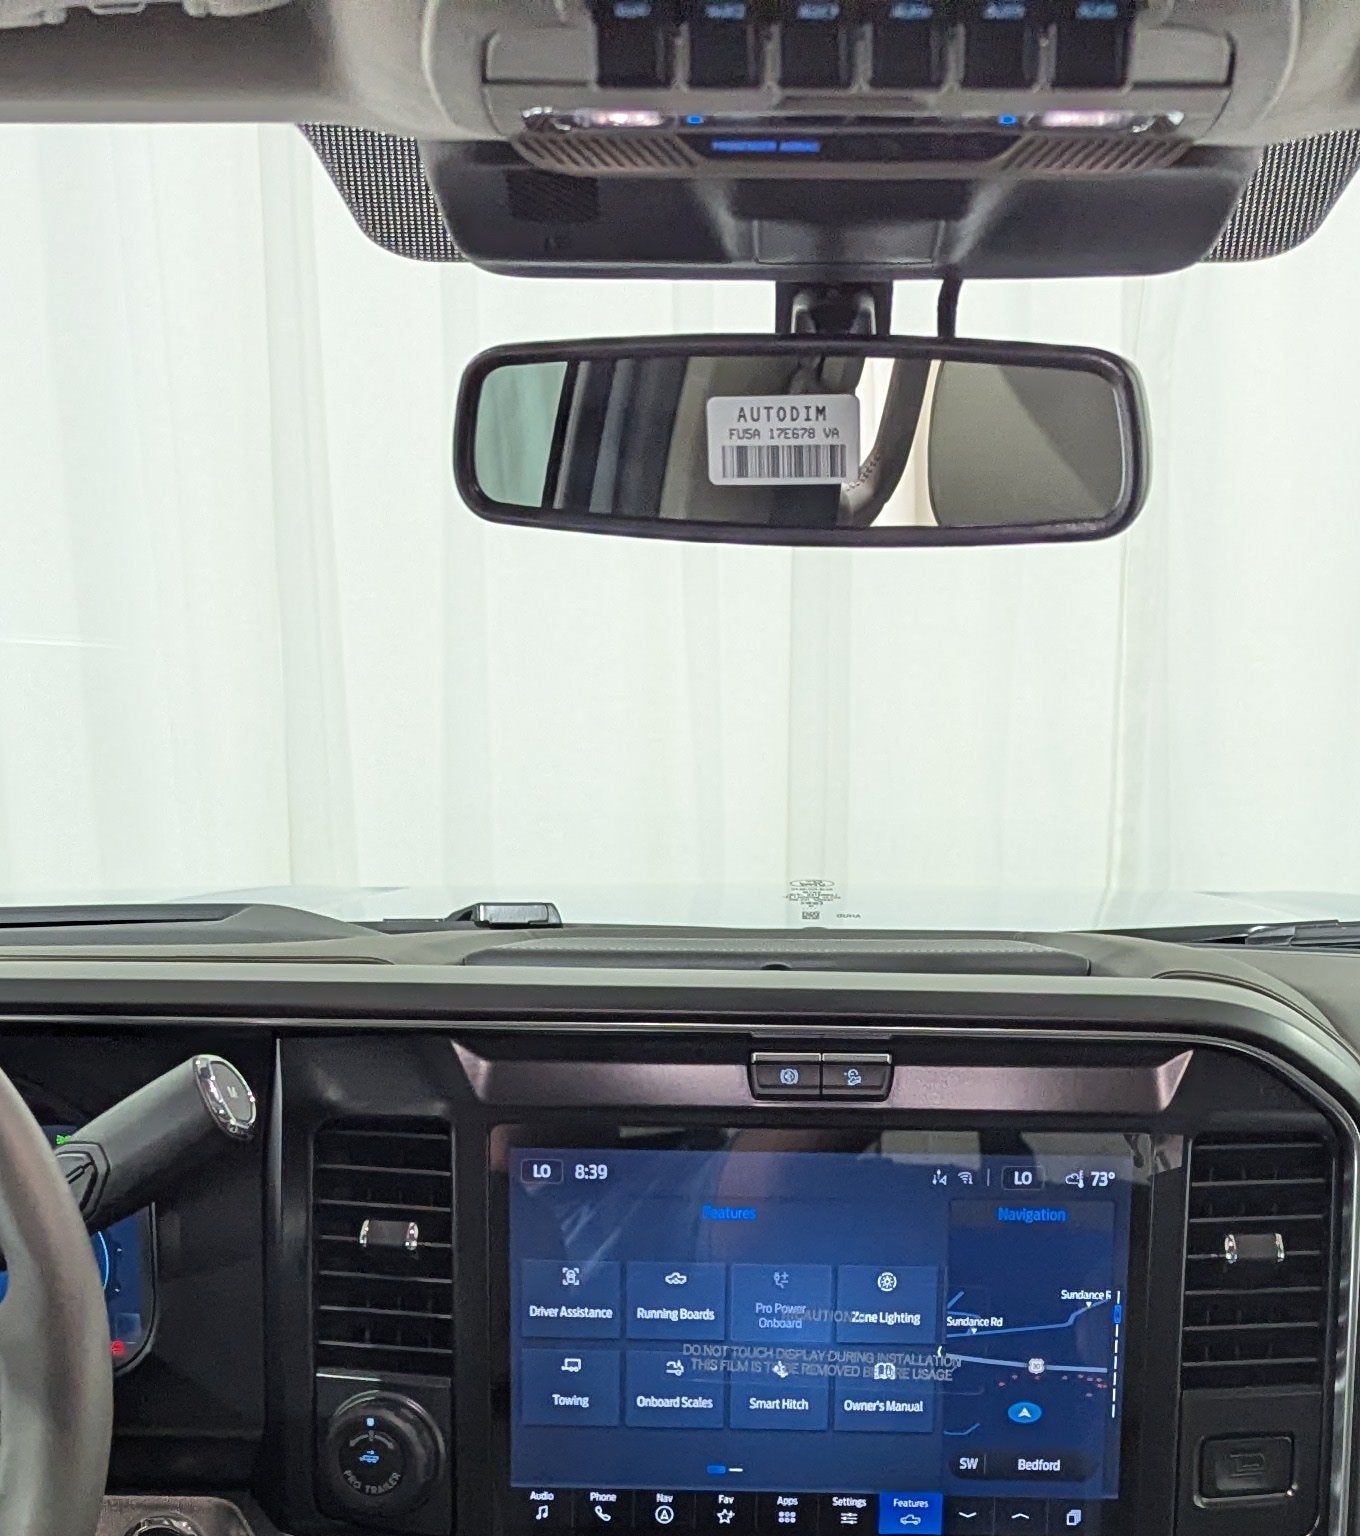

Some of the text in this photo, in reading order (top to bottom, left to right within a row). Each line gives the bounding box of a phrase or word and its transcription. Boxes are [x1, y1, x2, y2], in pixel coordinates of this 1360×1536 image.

[737, 406, 827, 422] AUTODIM
[769, 428, 815, 440] 17E678
[823, 427, 840, 439] VA
[532, 1164, 608, 1180] LO 8:39
[1014, 1171, 1116, 1187] LO 73°
[702, 1205, 757, 1220] Features
[998, 1207, 1067, 1223] Navigation
[1061, 1290, 1105, 1300] Sundance
[529, 1305, 613, 1319] Driver Assistance
[636, 1307, 715, 1322] Running Boards
[755, 1303, 807, 1315] Pro Power
[758, 1317, 803, 1329] Onboard
[852, 1311, 921, 1326] Zone Lighting
[946, 1316, 1003, 1327] Sundance Rd
[683, 1344, 702, 1356] DO
[703, 1345, 728, 1358] NOT
[733, 1346, 774, 1359] TOUCH
[776, 1348, 826, 1361] DISPLAY
[828, 1350, 875, 1364] DURING
[691, 1358, 718, 1370] THIS
[720, 1359, 749, 1372] FILM
[751, 1361, 762, 1373] IS
[801, 1363, 861, 1377] REMOVED
[912, 1368, 953, 1381] USAGE
[551, 1394, 590, 1408] Towing
[636, 1395, 714, 1409] Onboard Scales
[749, 1398, 809, 1410] Smart Hitch
[843, 1400, 924, 1413] Owner's Manual
[959, 1457, 1061, 1471] SW Bedford
[529, 1491, 555, 1501] Audio
[590, 1491, 617, 1502] Phone
[655, 1493, 674, 1503] Nav
[718, 1494, 734, 1504] Fav
[777, 1496, 799, 1506] Apps
[832, 1496, 867, 1508] Settings
[893, 1498, 929, 1508] Features
